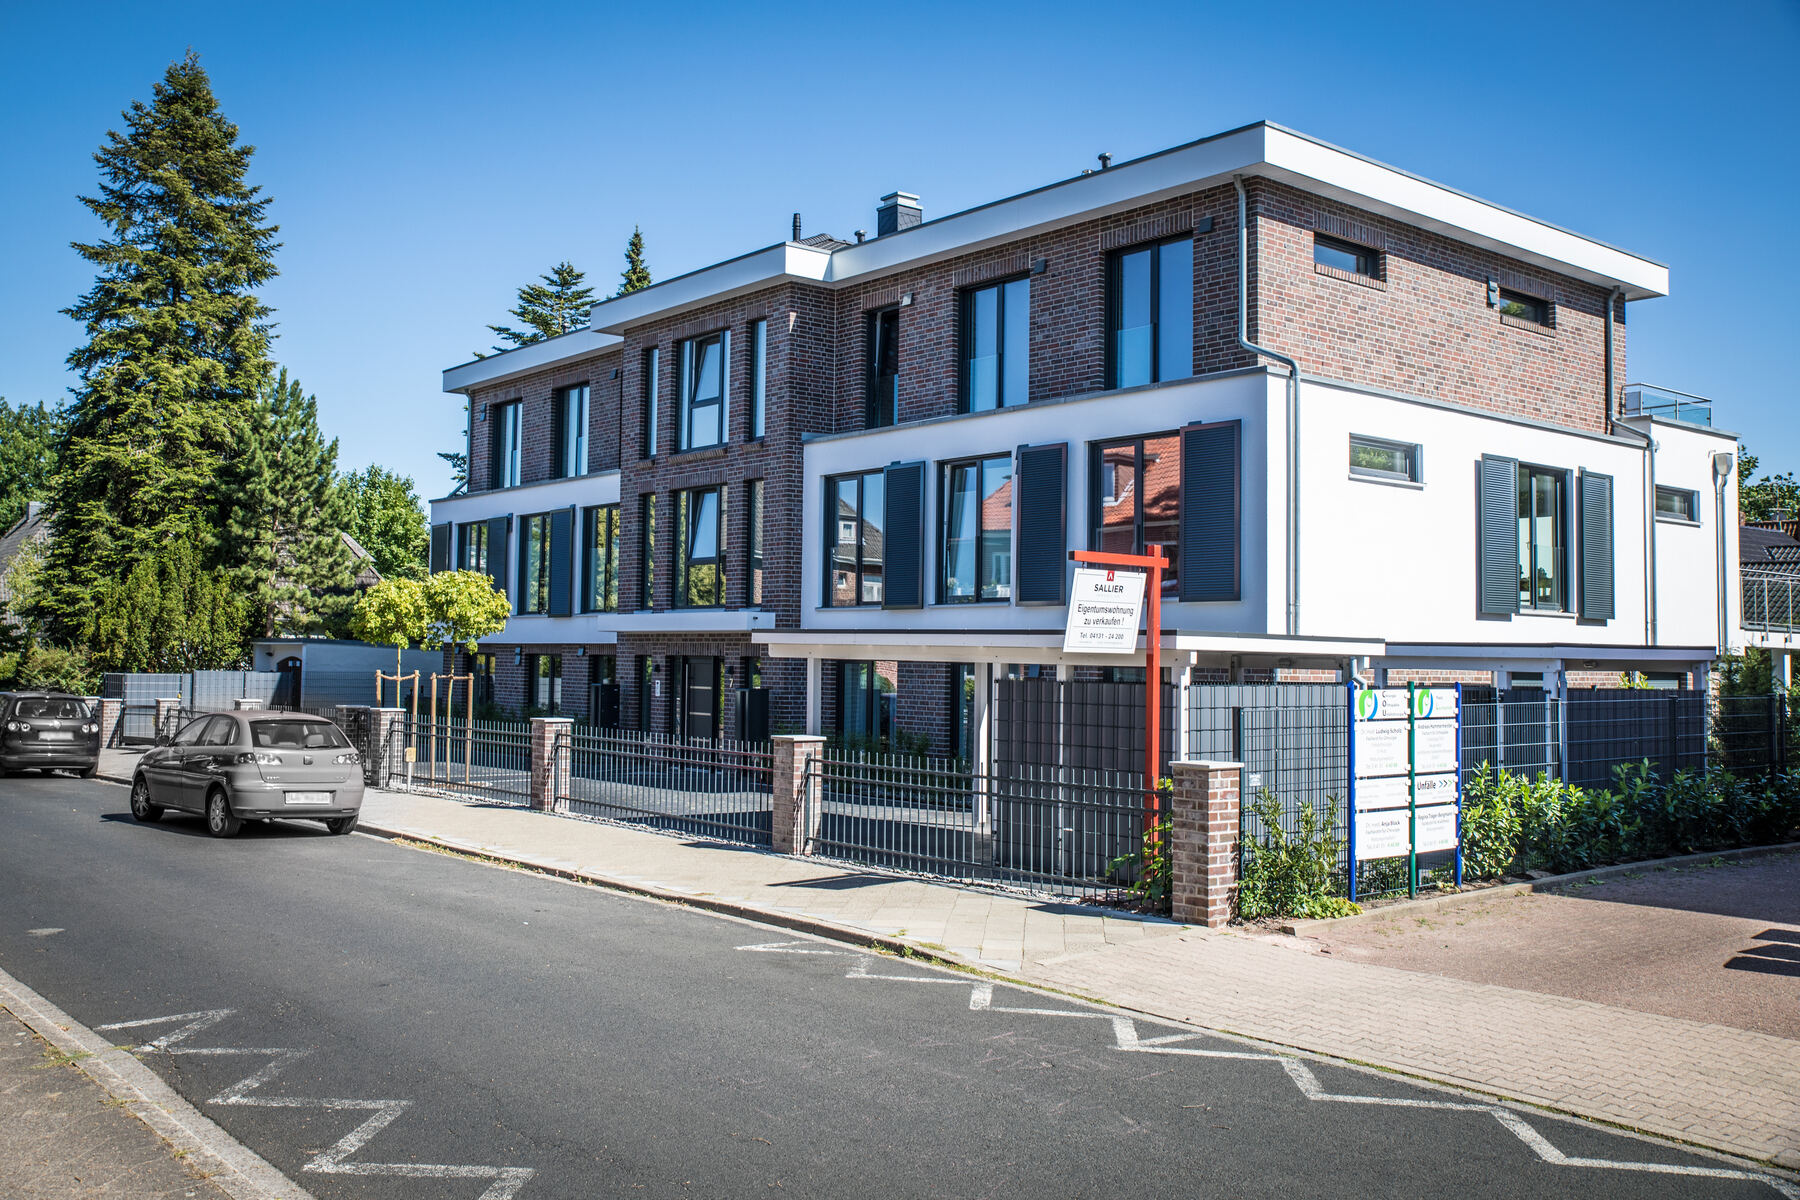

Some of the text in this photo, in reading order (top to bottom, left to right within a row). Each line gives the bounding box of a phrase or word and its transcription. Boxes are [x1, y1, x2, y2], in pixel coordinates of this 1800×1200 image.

[1094, 584, 1124, 593] SALLIER
[1077, 604, 1134, 616] Eigentumswohnung
[1092, 616, 1120, 626] verkaufen
